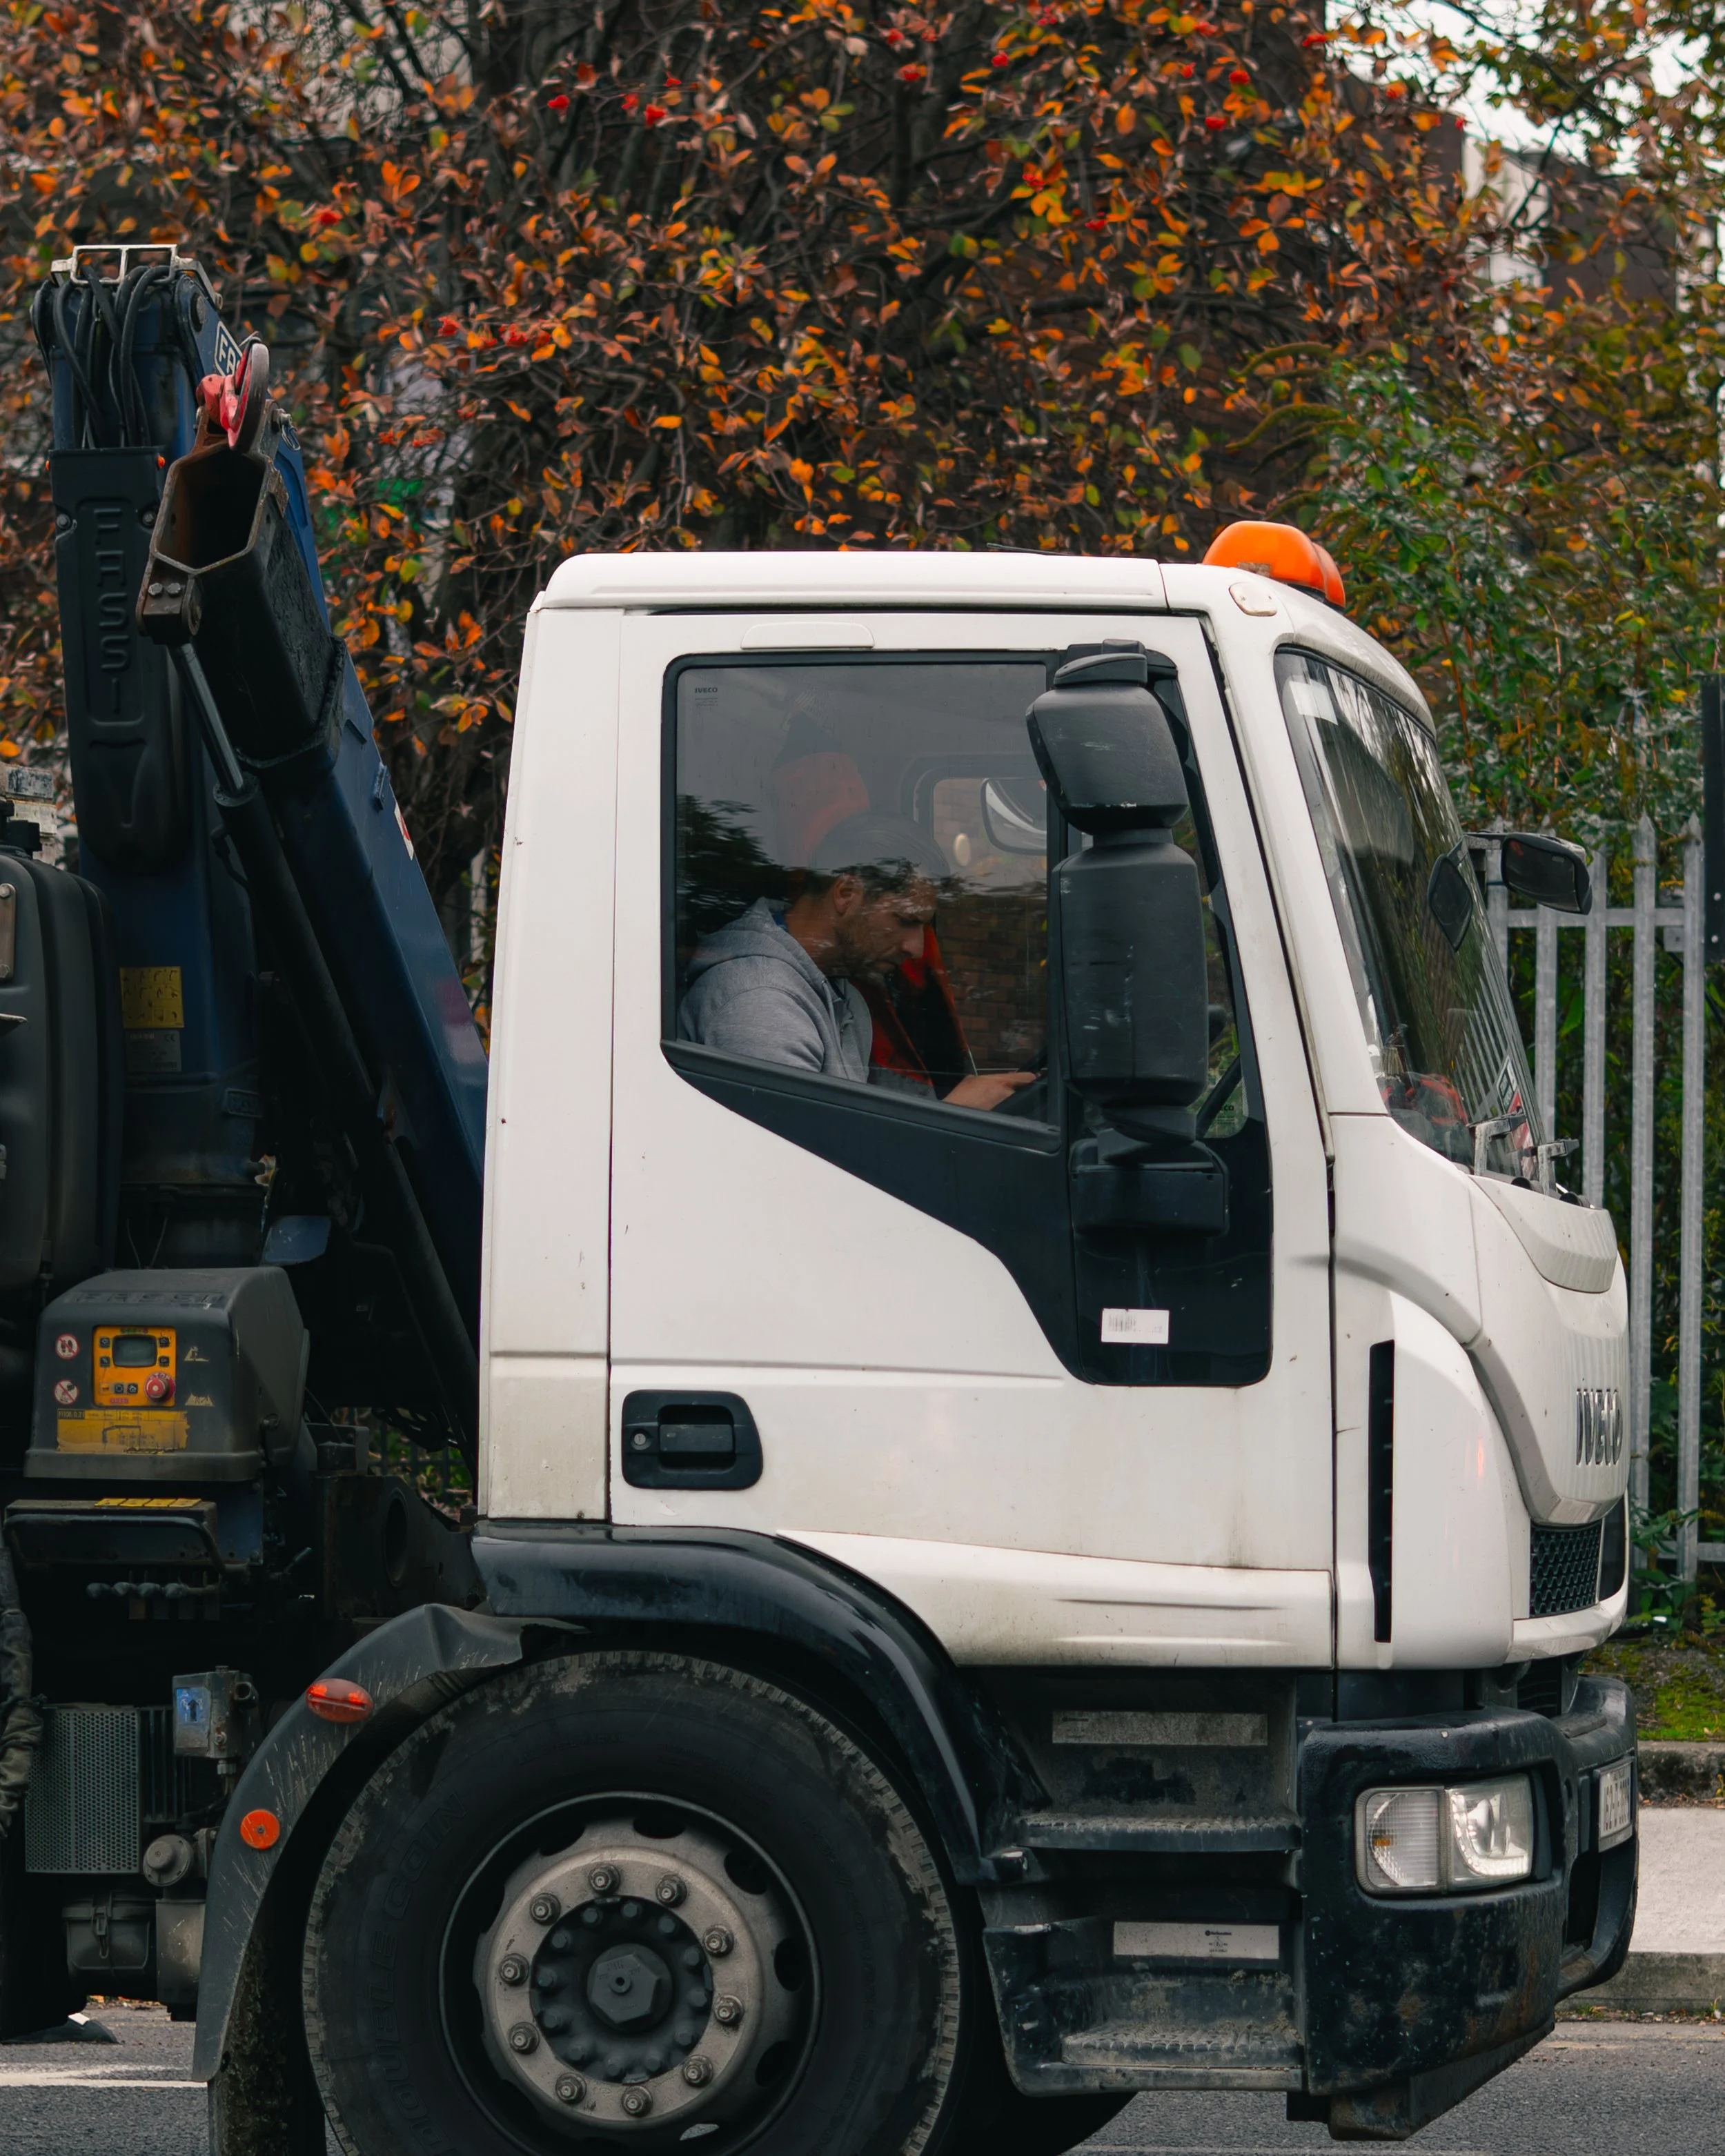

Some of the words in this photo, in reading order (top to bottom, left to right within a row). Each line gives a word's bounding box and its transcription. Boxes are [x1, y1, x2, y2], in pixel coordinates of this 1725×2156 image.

[218, 333, 240, 376] FA
[93, 507, 130, 714] FASSI
[1576, 1388, 1624, 1465] IVECO
[382, 1790, 470, 1920] COIN
[369, 1928, 456, 2155] DOUBLE
